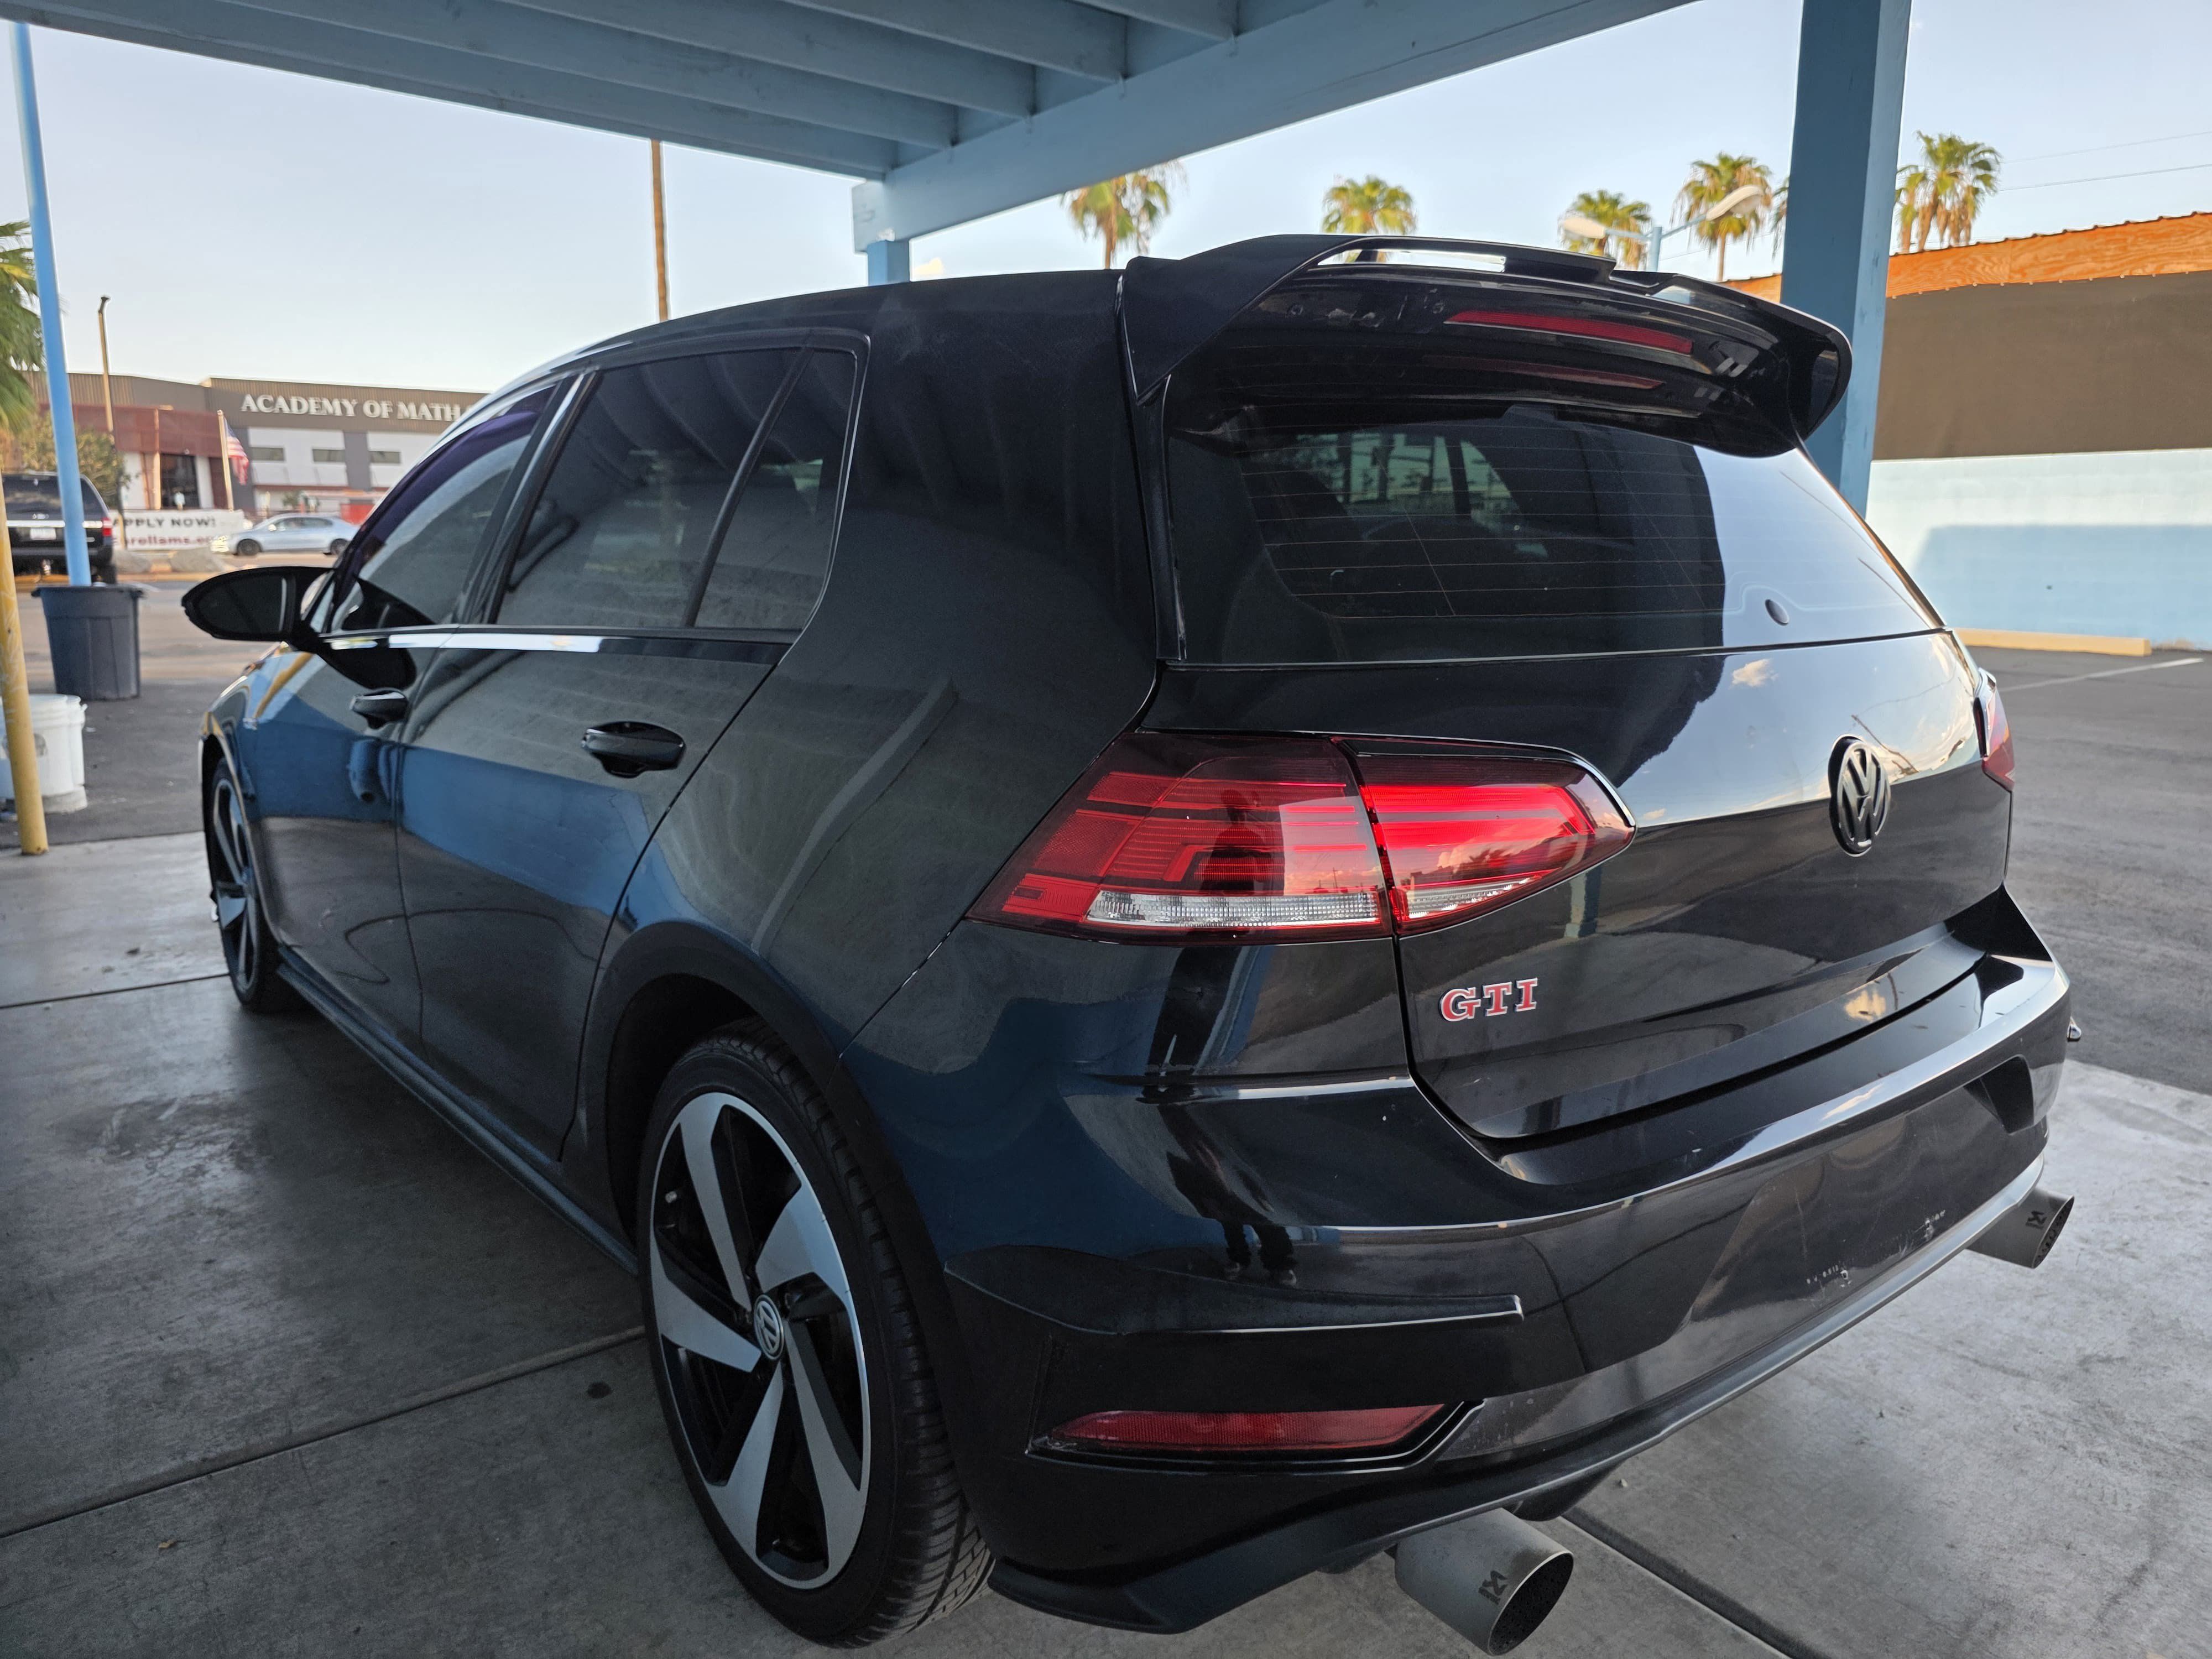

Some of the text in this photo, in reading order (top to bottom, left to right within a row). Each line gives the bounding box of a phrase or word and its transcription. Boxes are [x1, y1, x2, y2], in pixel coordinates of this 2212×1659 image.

[240, 393, 358, 416] ACADEMY
[362, 399, 393, 419] OF
[397, 401, 460, 422] MATH
[1439, 977, 1538, 1022] GTI
